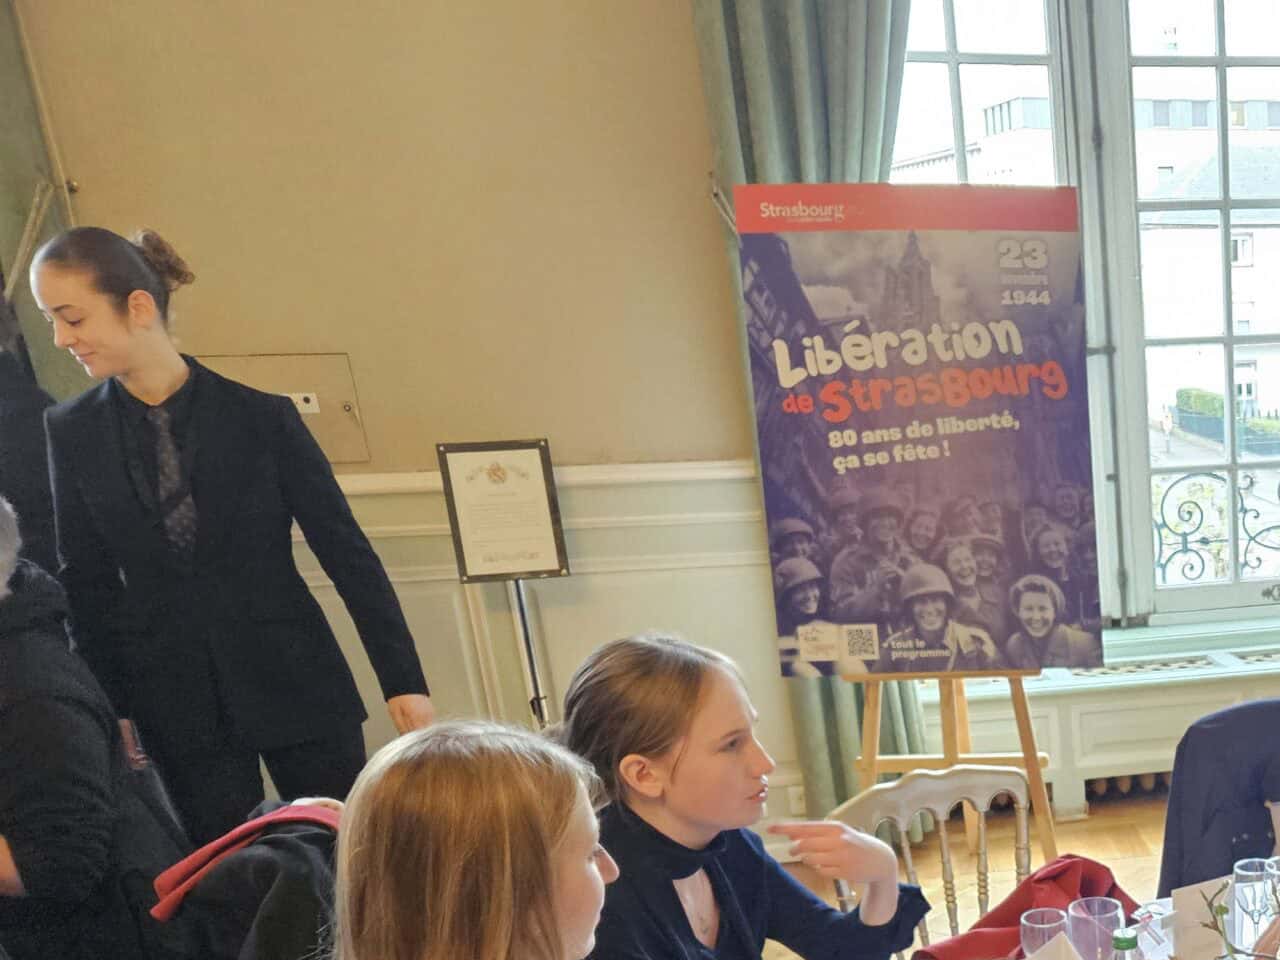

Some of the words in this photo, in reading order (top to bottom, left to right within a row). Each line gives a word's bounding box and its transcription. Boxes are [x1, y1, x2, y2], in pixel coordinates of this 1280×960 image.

[759, 200, 845, 223] Strasbourg
[998, 239, 1049, 269] 23
[1000, 290, 1051, 305] 1944
[772, 319, 1023, 389] Libération
[782, 393, 815, 413] de
[828, 429, 858, 448] 80
[861, 427, 902, 444] ans
[905, 421, 934, 438] de
[936, 410, 1020, 435] liberté,
[833, 455, 860, 475] ça
[863, 451, 890, 466] se
[893, 444, 940, 463] fête
[891, 638, 914, 649] tout
[916, 638, 926, 649] le
